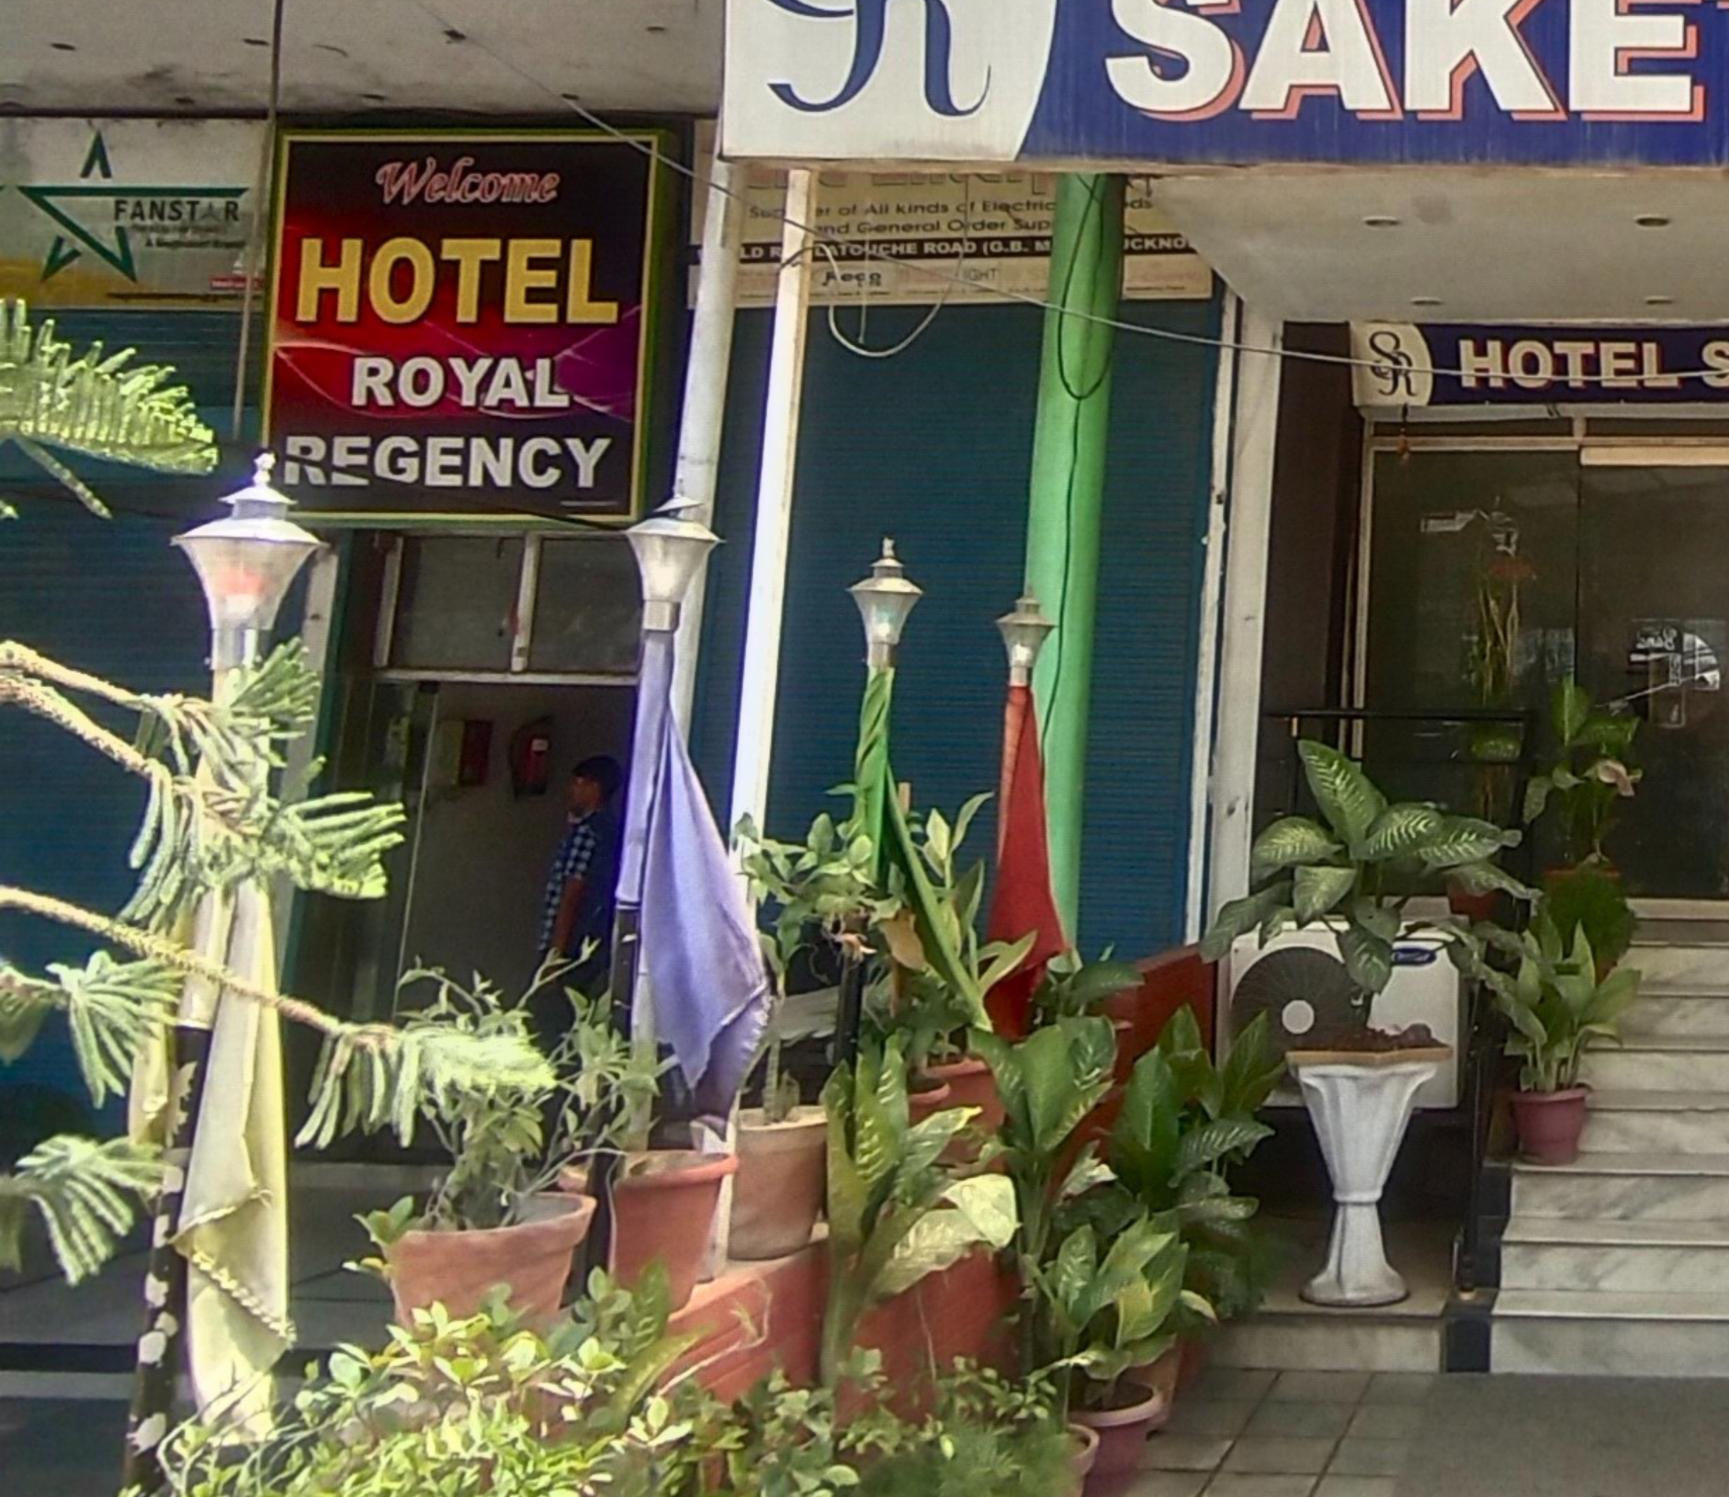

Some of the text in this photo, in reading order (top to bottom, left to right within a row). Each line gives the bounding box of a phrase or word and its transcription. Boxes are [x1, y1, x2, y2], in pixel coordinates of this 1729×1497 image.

[374, 155, 561, 205] Welcome
[837, 204, 859, 217] of
[866, 201, 890, 216] All
[955, 200, 977, 213] of
[856, 219, 941, 235] General
[947, 218, 1006, 232] Order
[923, 241, 977, 255] ROAD
[295, 236, 619, 325] HOTEL
[350, 355, 571, 409] ROYAL
[1458, 338, 1681, 390] HOTEL
[283, 435, 613, 489] REGENCY
